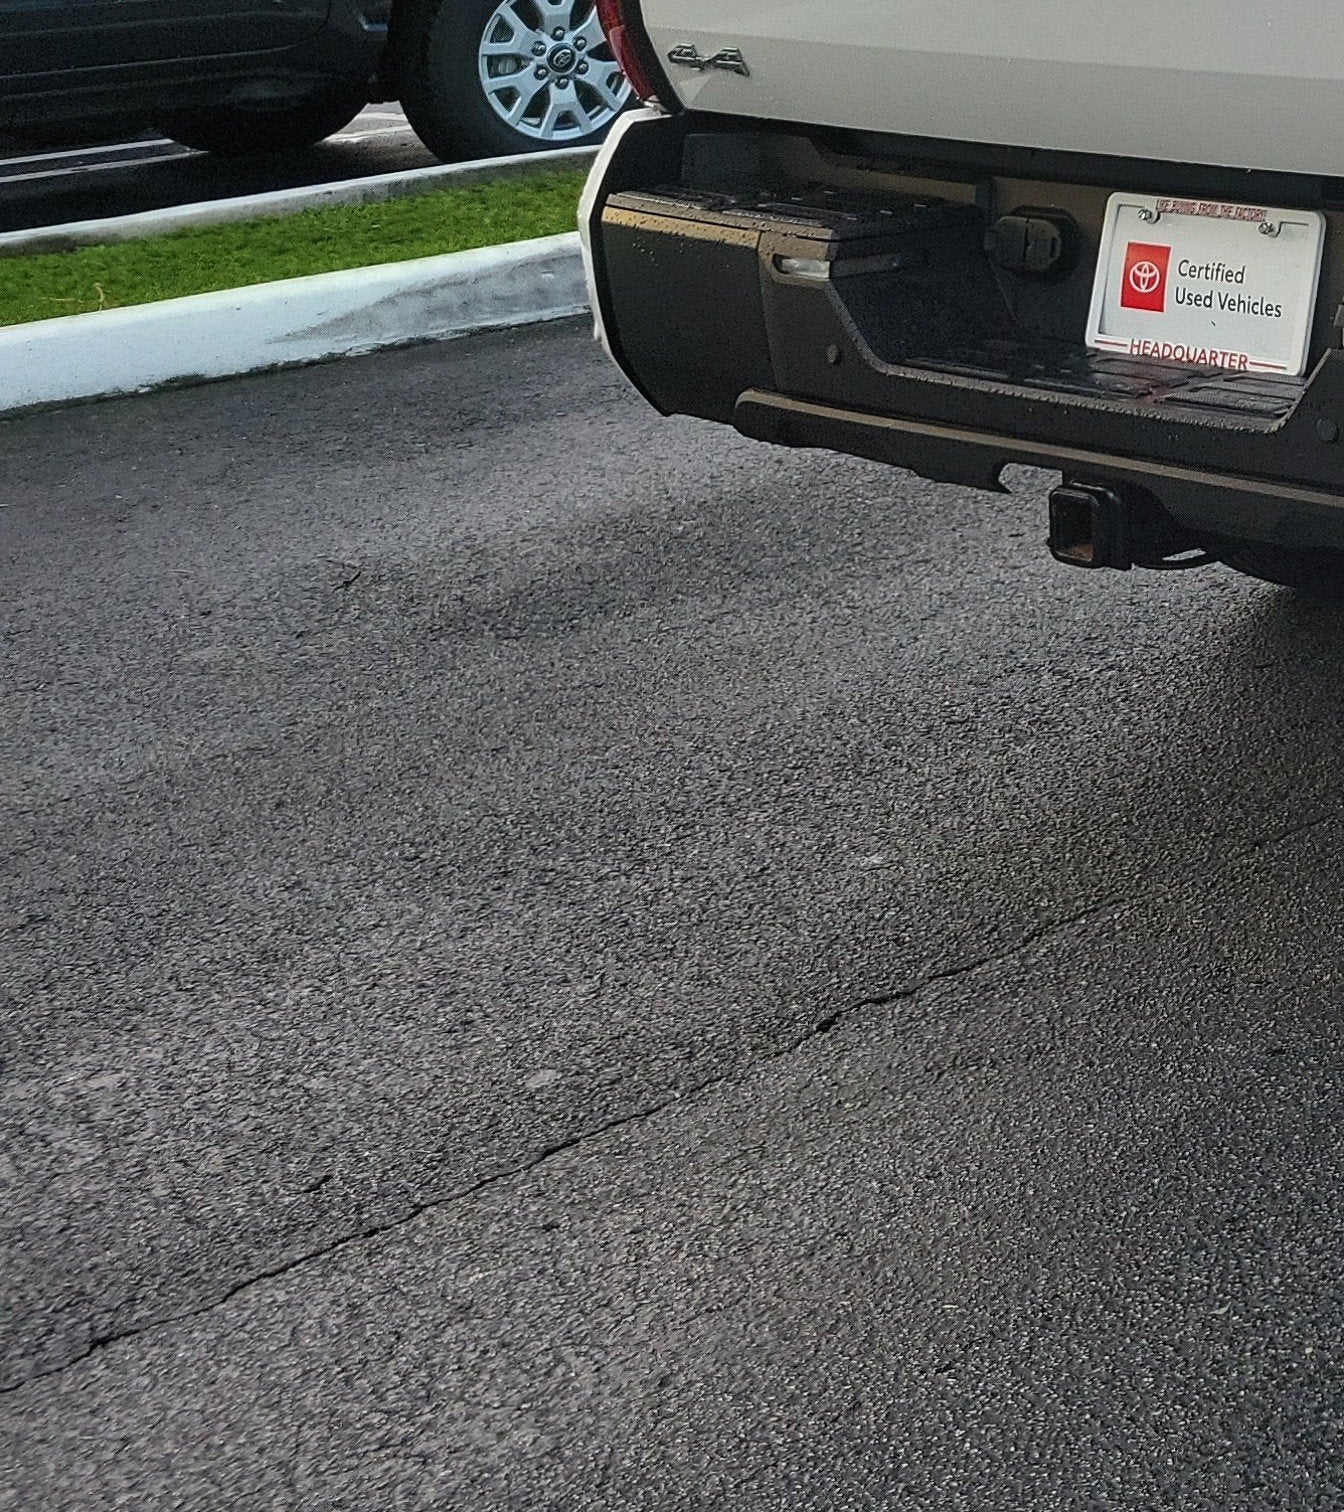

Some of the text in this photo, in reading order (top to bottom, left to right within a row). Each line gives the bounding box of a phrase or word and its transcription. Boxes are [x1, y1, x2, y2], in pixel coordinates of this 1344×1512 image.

[1178, 259, 1246, 284] Certified
[1175, 286, 1282, 318] Used Vehicles
[1130, 338, 1249, 370] HEADQUARTER
